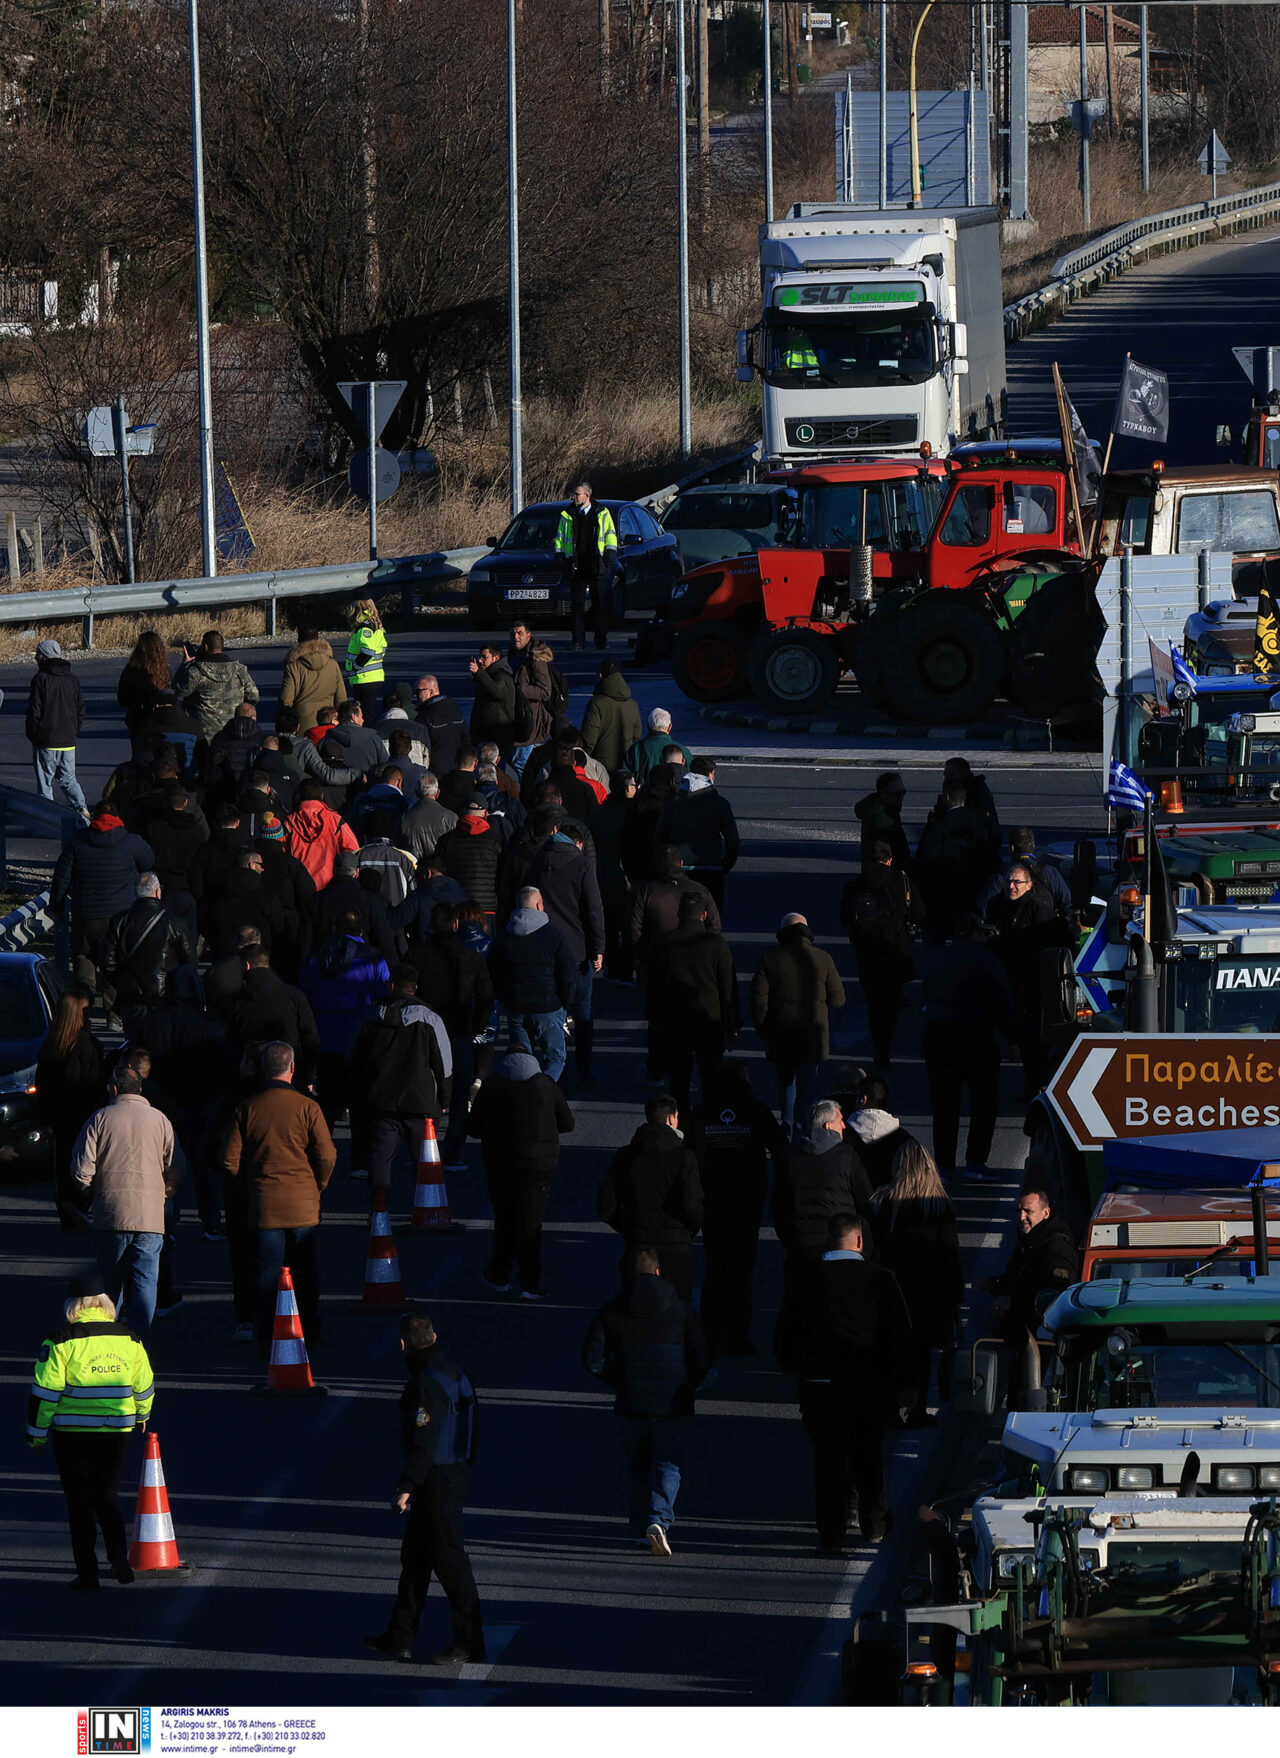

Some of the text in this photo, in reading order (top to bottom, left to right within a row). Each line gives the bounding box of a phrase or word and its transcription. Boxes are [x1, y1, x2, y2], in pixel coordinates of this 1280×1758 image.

[801, 286, 917, 304] SLT SAMARAS
[801, 428, 809, 439] L
[1126, 1097, 1280, 1127] Beaches
[92, 1365, 121, 1373] POLICE
